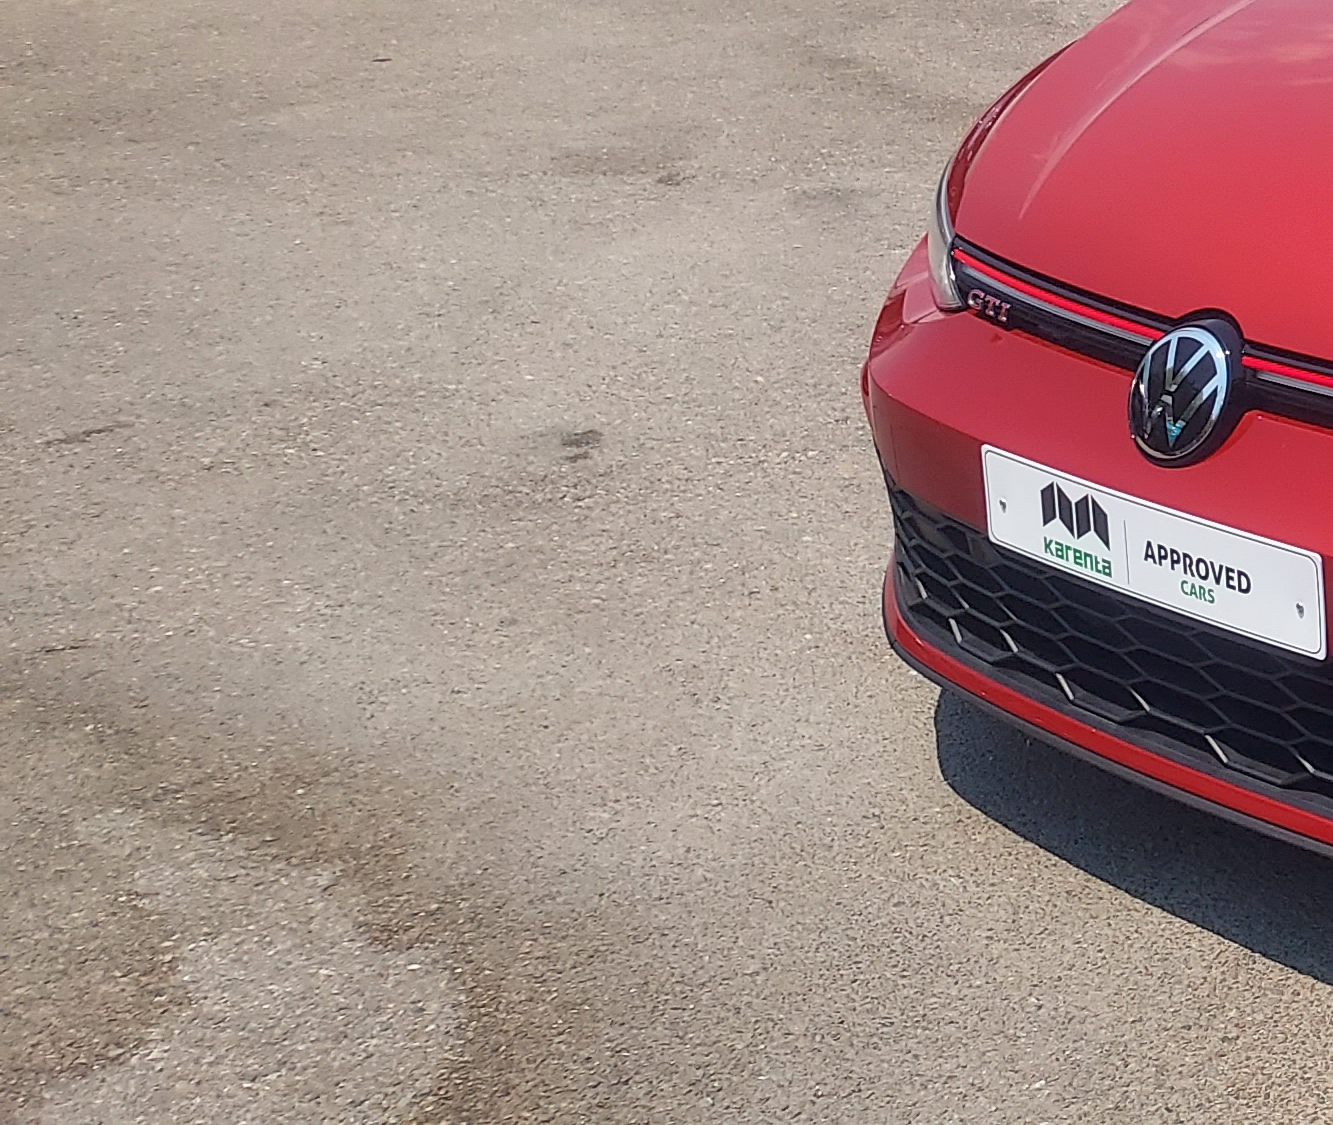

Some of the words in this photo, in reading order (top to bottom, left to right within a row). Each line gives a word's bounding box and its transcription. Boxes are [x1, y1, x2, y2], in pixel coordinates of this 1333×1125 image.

[967, 288, 1011, 323] GTI
[1143, 540, 1252, 595] APPROVED
[1180, 580, 1216, 605] CARS
